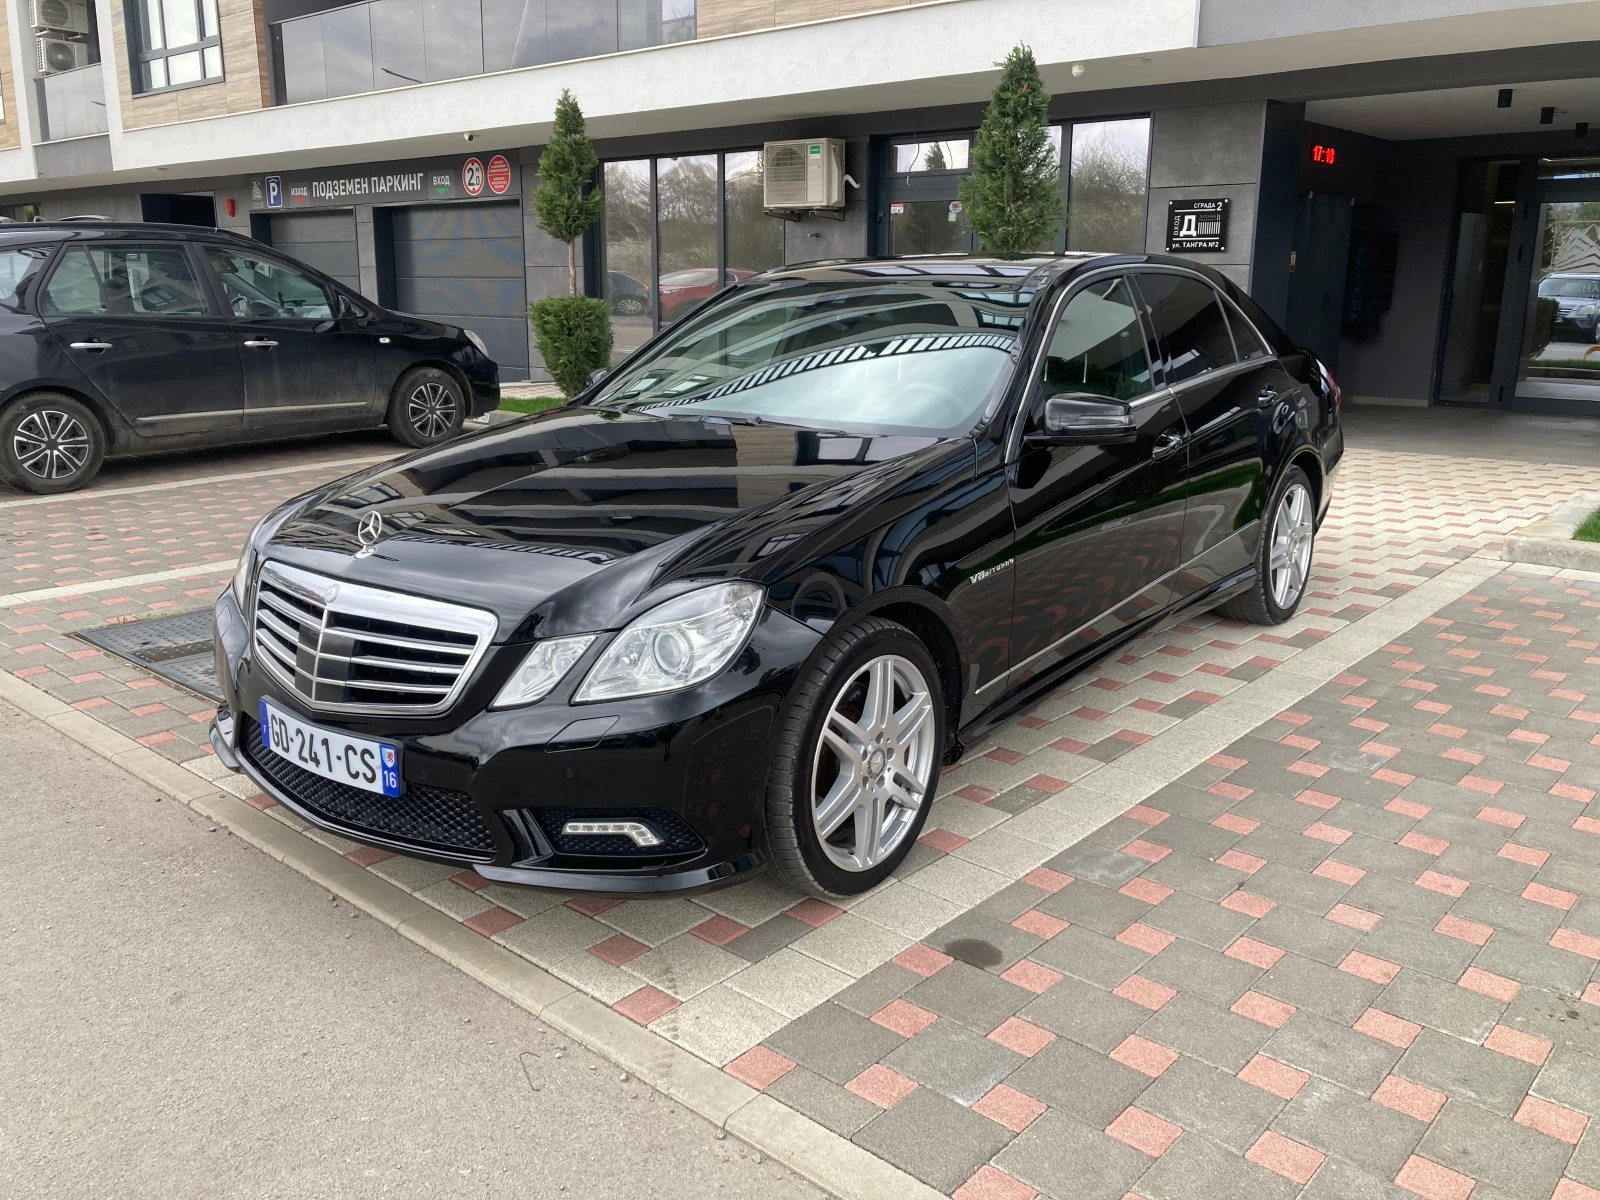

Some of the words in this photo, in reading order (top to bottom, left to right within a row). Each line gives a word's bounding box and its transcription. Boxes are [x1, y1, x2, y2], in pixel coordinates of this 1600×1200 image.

[312, 178, 369, 200] ПОДЗЕМЕН
[371, 173, 424, 194] ПАРКИНГ
[432, 175, 450, 187] ВХОД
[269, 182, 278, 204] P
[1216, 201, 1223, 211] 2
[1173, 215, 1181, 236] ВХОД
[1179, 214, 1197, 237] Д
[263, 724, 267, 734] F
[270, 713, 377, 784] GD-241-CS
[383, 770, 397, 789] 16
